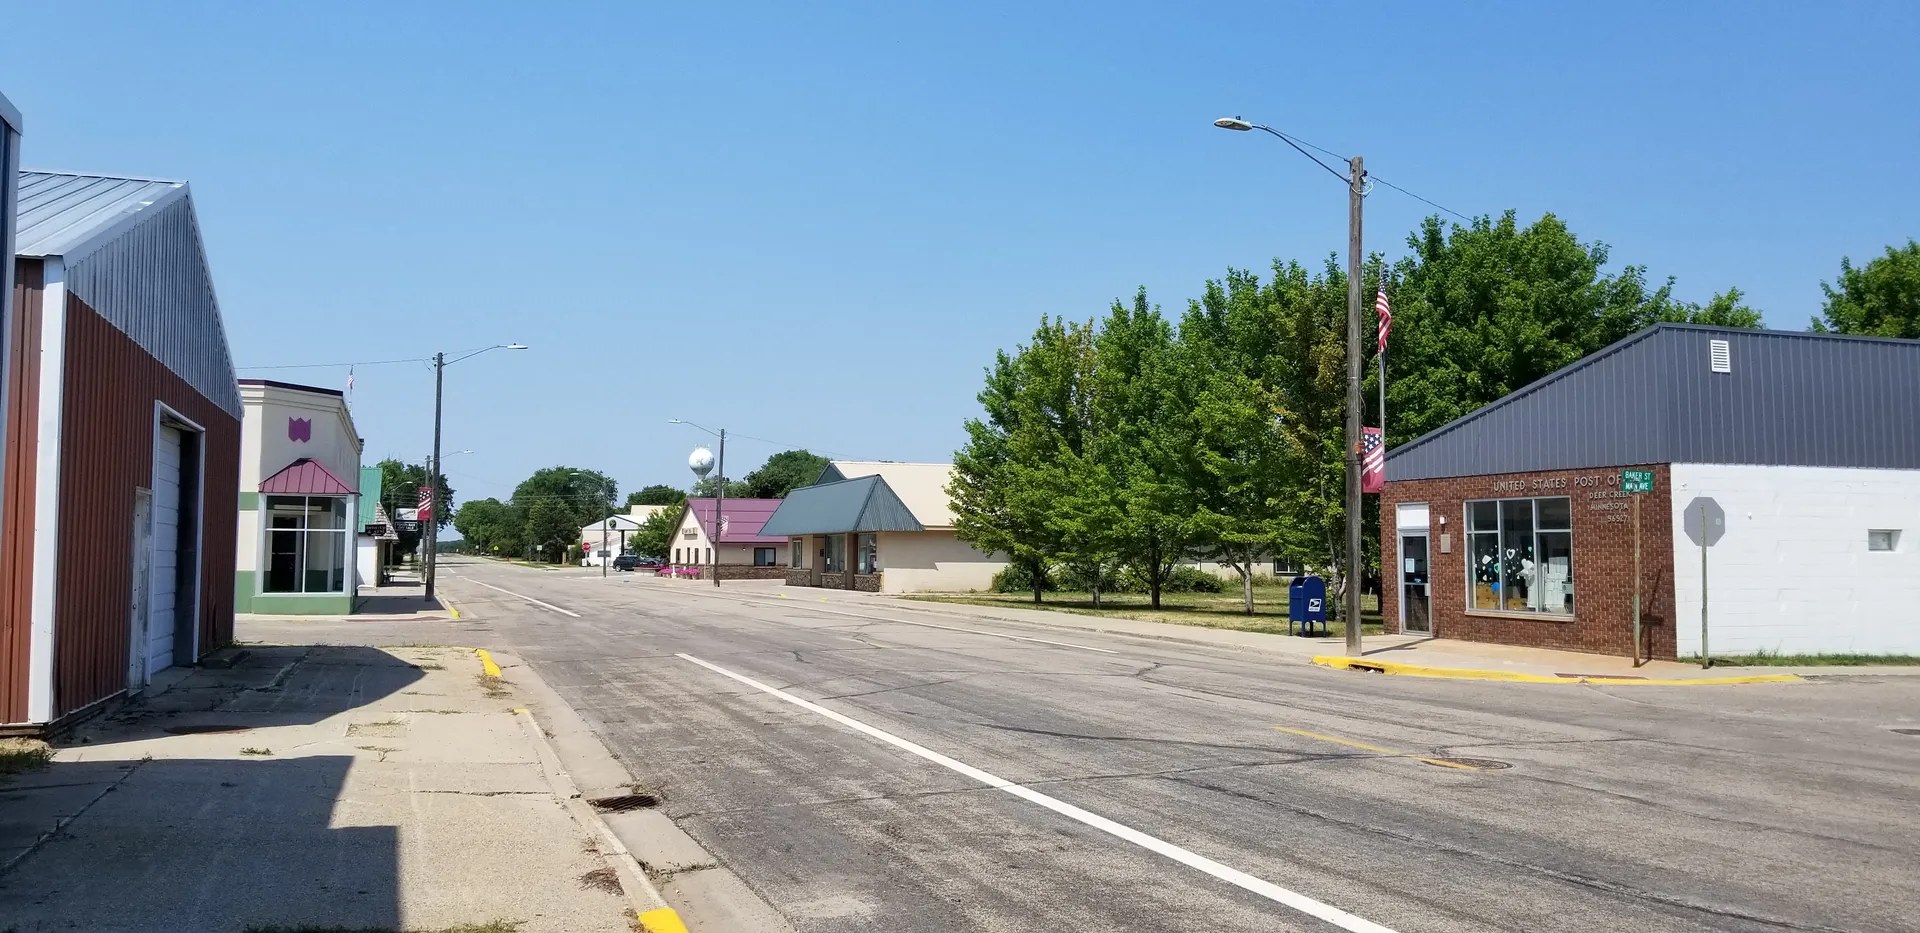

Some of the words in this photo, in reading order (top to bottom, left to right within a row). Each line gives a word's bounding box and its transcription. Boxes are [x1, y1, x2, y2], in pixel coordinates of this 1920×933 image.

[1624, 471, 1642, 480] BAKER
[1644, 472, 1651, 480] ST
[1493, 480, 1525, 491] UNITED
[1532, 479, 1566, 489] STATES
[1574, 476, 1600, 486] POST
[1607, 474, 1622, 485] OF
[1639, 482, 1649, 490] AVE
[1589, 491, 1607, 499] DEER
[1608, 490, 1632, 498] CREEK
[1590, 502, 1628, 510] MINNESOTA
